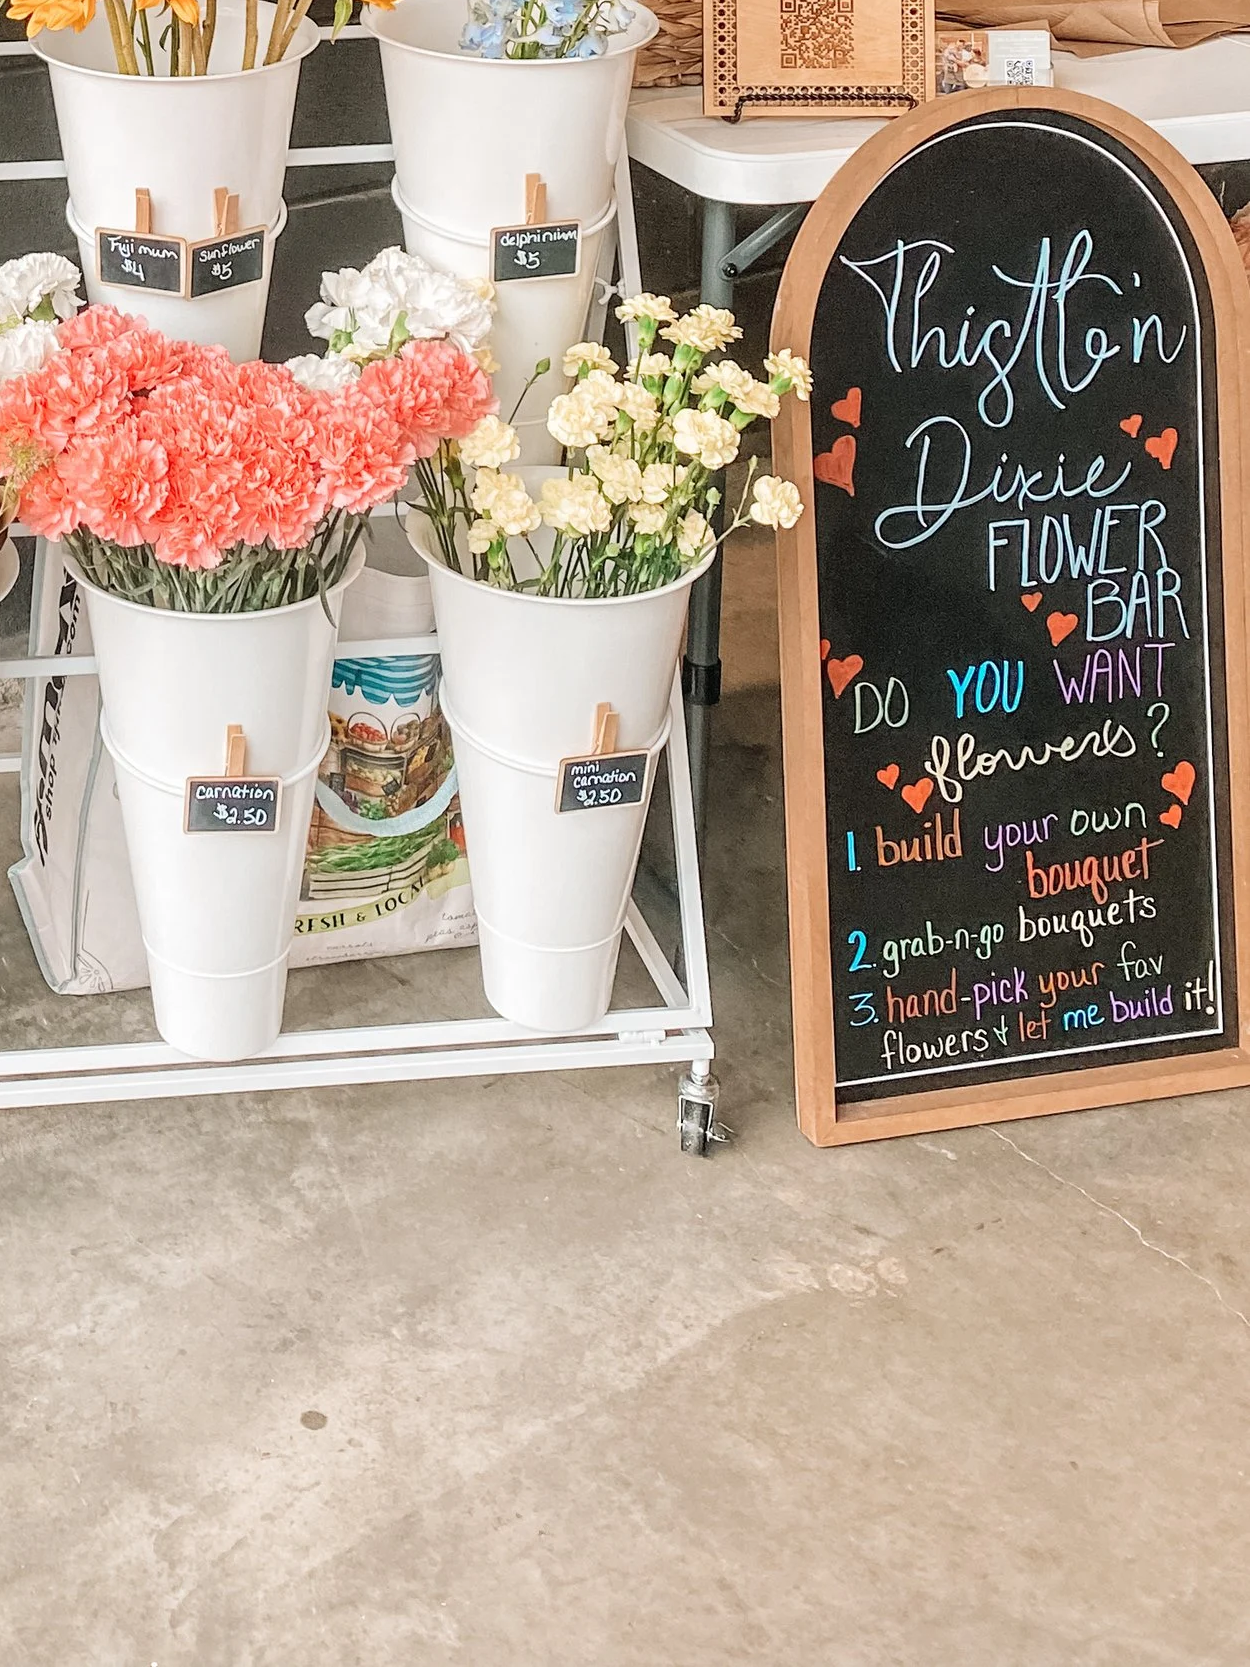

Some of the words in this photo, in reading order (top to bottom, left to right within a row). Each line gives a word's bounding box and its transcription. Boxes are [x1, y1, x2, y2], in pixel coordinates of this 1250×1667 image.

[107, 235, 135, 257] Fuji
[138, 246, 178, 260] mum
[121, 258, 146, 282] $4
[211, 261, 233, 280] $5
[513, 250, 541, 269] $5
[874, 415, 1132, 549] Dixie
[988, 499, 1168, 592] FLOWER
[1085, 567, 1190, 642] BAR
[854, 676, 909, 734] DO
[947, 660, 1024, 719] YOU
[1052, 642, 1176, 705] WANT
[571, 761, 600, 775] mini
[573, 769, 637, 788] carnation
[213, 803, 268, 825] $2.50
[576, 788, 622, 806] $2.50
[874, 808, 963, 867] build
[984, 813, 1059, 873] your
[1070, 802, 1147, 836] own
[1025, 837, 1165, 905] bouquet
[295, 913, 345, 933] RESH
[356, 912, 366, 922] &
[848, 930, 877, 972] 2.
[882, 920, 1004, 978] grab-n-go
[1018, 888, 1157, 948] bouquets
[848, 992, 879, 1026] 3.
[886, 966, 1029, 1022] hand-pick
[1038, 961, 1105, 1009] your
[1116, 940, 1163, 982] fav
[881, 1029, 990, 1070] flowers
[1018, 1010, 1052, 1043] let
[1062, 1003, 1105, 1032] me
[1109, 984, 1174, 1024] build
[1184, 959, 1215, 1016] it!
